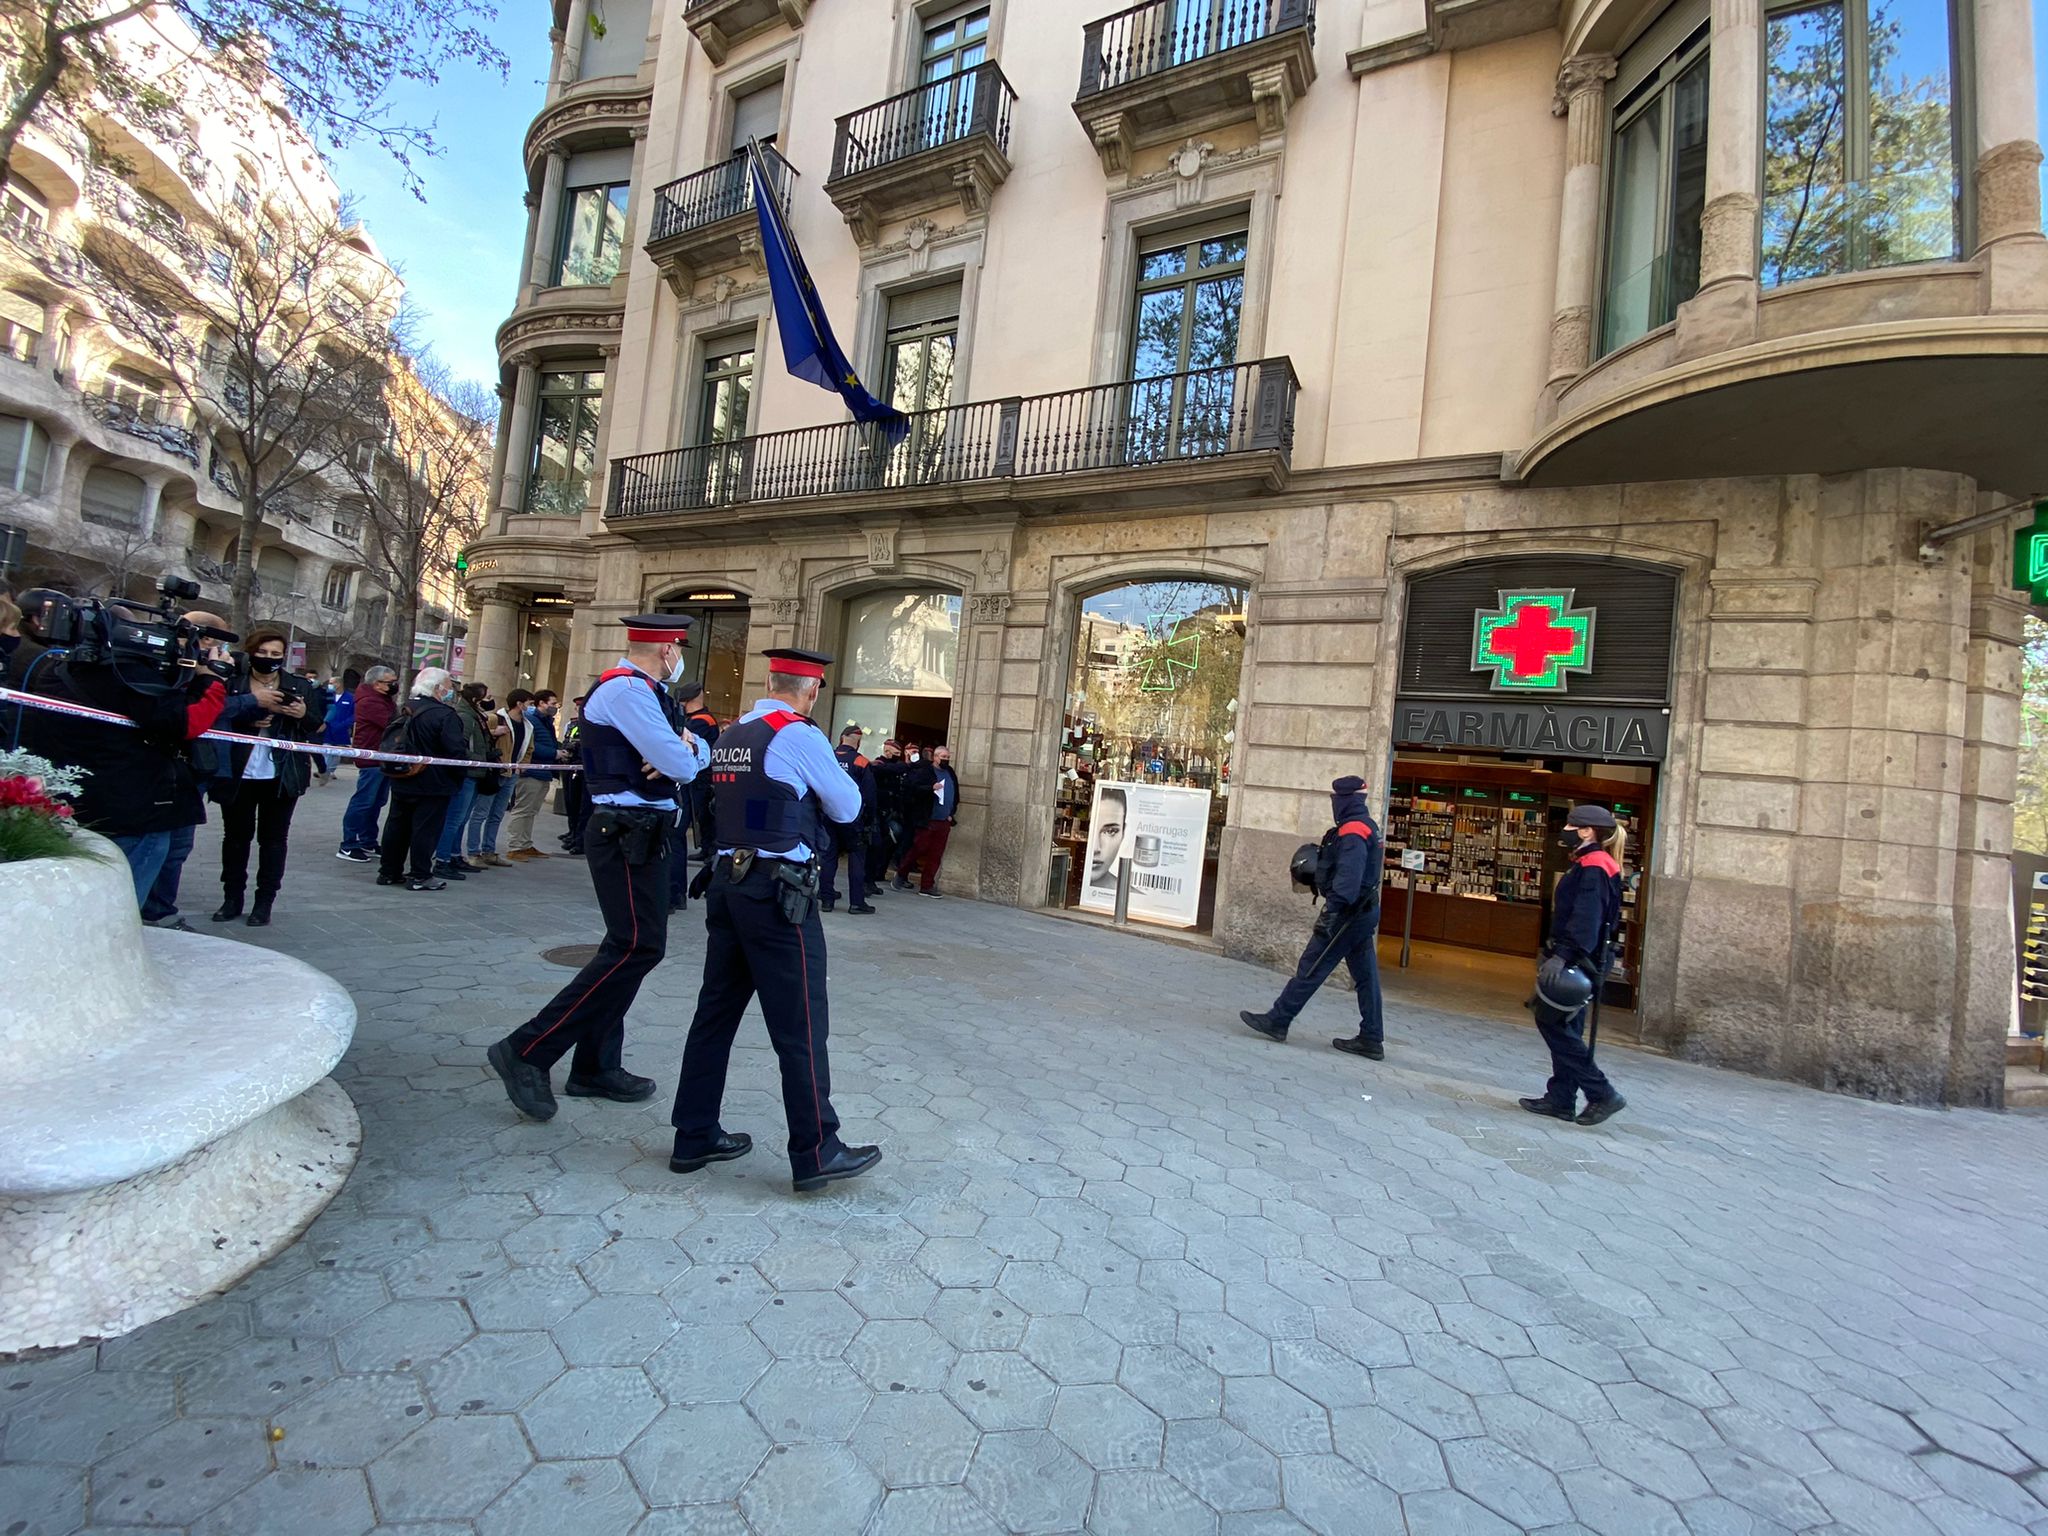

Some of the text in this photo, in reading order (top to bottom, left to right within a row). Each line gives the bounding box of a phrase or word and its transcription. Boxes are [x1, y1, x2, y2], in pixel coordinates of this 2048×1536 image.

[1400, 705, 1655, 755] FARMÀCIA
[711, 747, 751, 763] POLICIA
[1136, 821, 1189, 838] Antiarrugas
